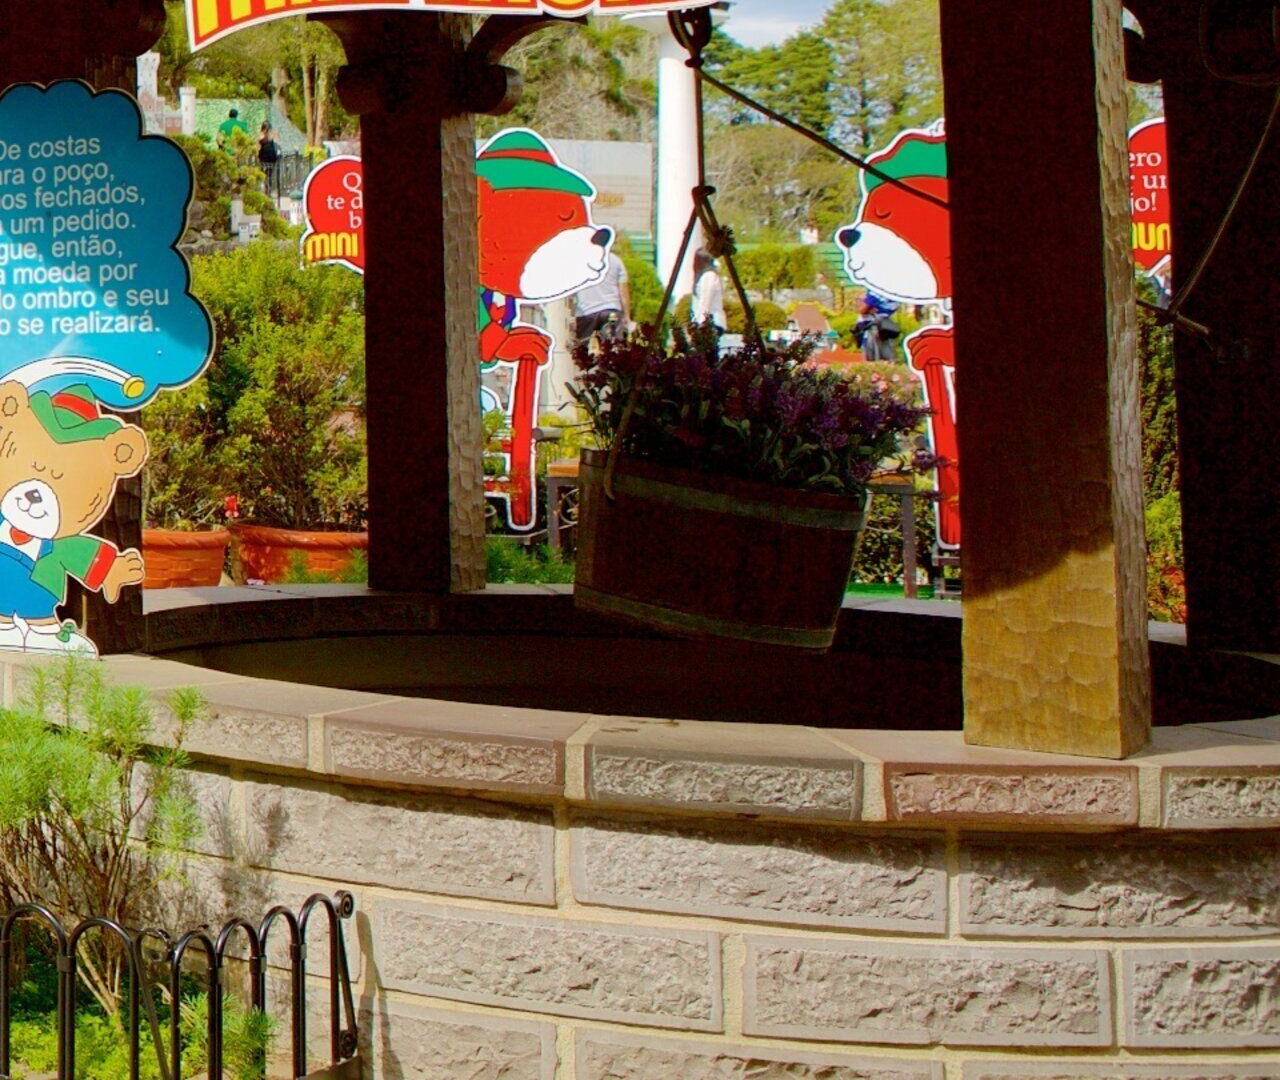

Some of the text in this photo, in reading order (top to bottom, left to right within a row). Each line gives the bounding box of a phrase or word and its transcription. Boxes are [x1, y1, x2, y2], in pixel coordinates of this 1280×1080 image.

[28, 136, 101, 159] costas
[32, 167, 46, 184] o
[54, 162, 115, 187] poço,
[34, 184, 145, 208] fechados,
[327, 194, 345, 210] te
[10, 215, 44, 234] um
[52, 210, 136, 237] pedido.
[52, 235, 123, 259] então,
[13, 262, 91, 284] moeda
[99, 263, 138, 287] por
[23, 287, 96, 309] ombro
[103, 290, 118, 307] e
[126, 288, 169, 306] seu
[17, 318, 42, 336] se
[51, 310, 160, 334] realizará.
